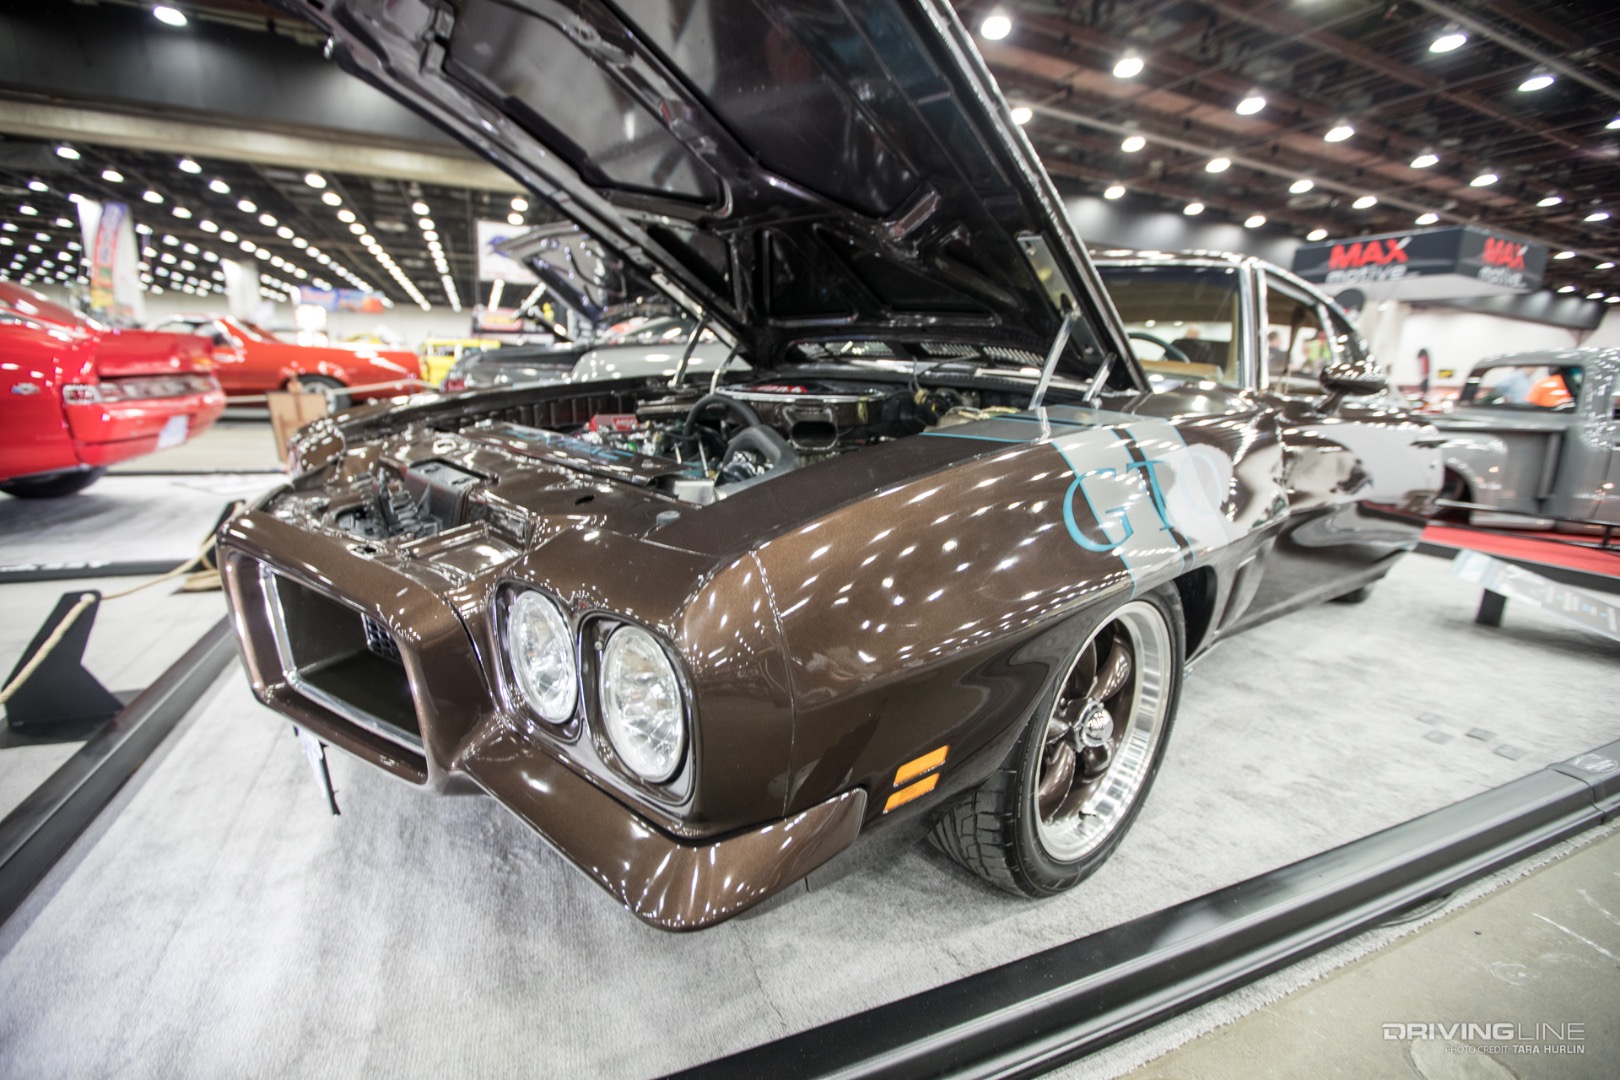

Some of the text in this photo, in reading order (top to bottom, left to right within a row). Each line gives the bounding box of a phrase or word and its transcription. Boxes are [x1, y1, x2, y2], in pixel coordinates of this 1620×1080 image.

[1328, 237, 1412, 270] MAX
[1482, 237, 1528, 270] MAX
[1063, 451, 1223, 552] GTO
